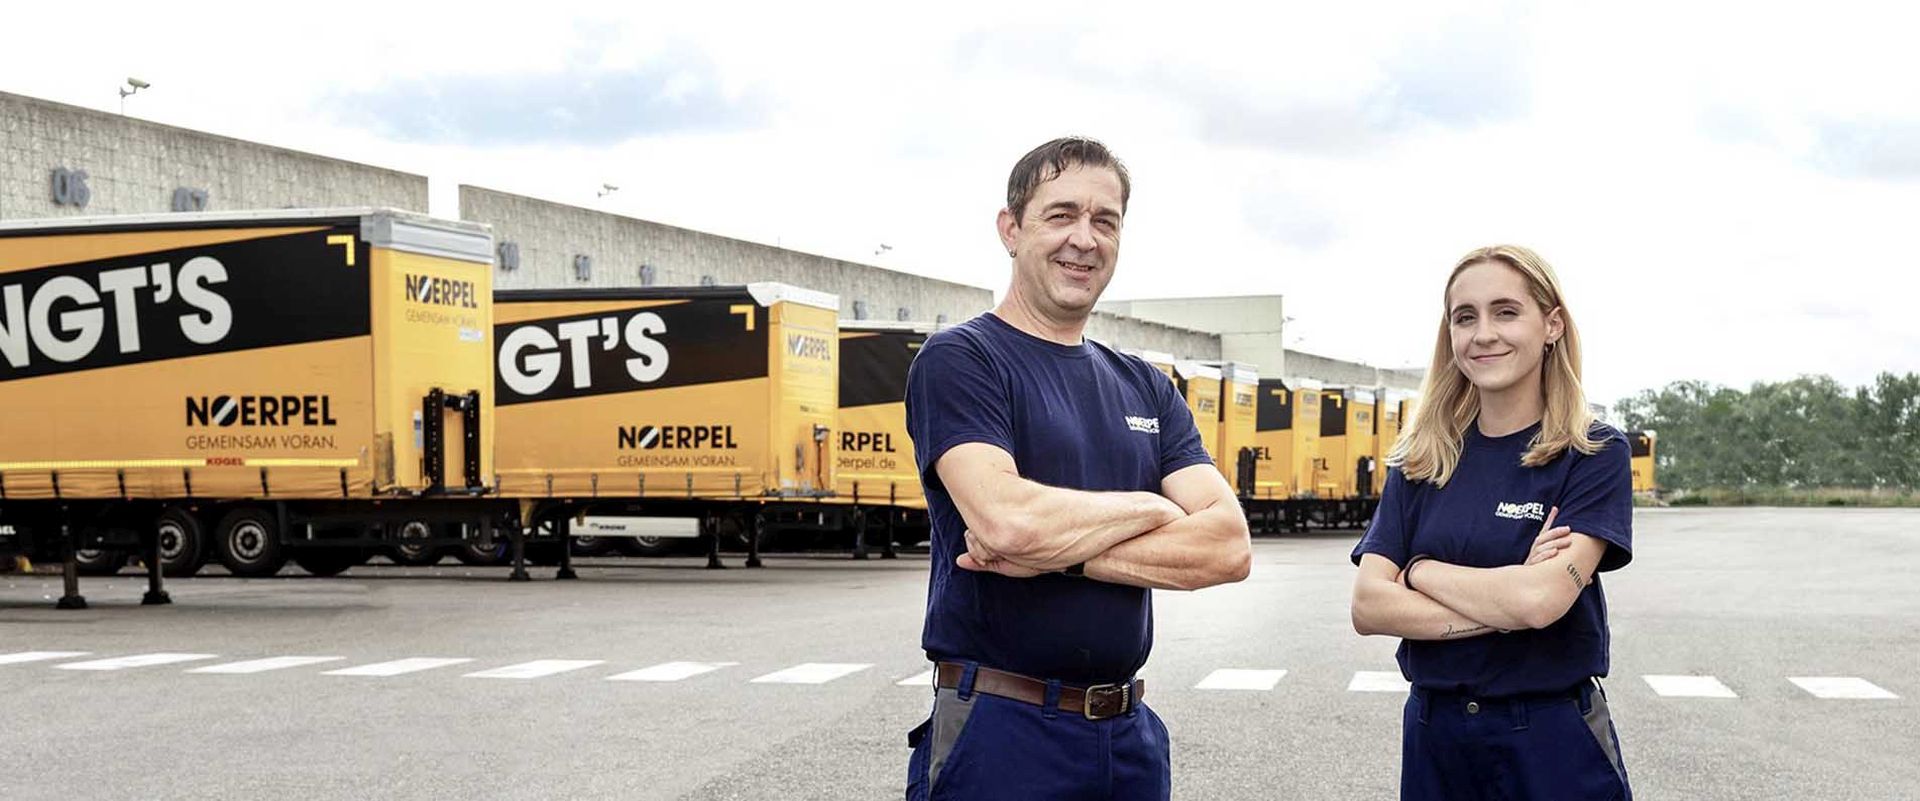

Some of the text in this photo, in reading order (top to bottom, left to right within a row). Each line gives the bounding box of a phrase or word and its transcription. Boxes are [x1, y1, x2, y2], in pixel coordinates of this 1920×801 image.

[53, 167, 90, 209] 06
[405, 273, 477, 309] NOERPEL
[185, 395, 337, 427] NOERPEL
[185, 435, 338, 450] GEMEINSAM VORAN.
[618, 425, 738, 450] NOERPEL
[617, 455, 689, 467] GEMEINSAM
